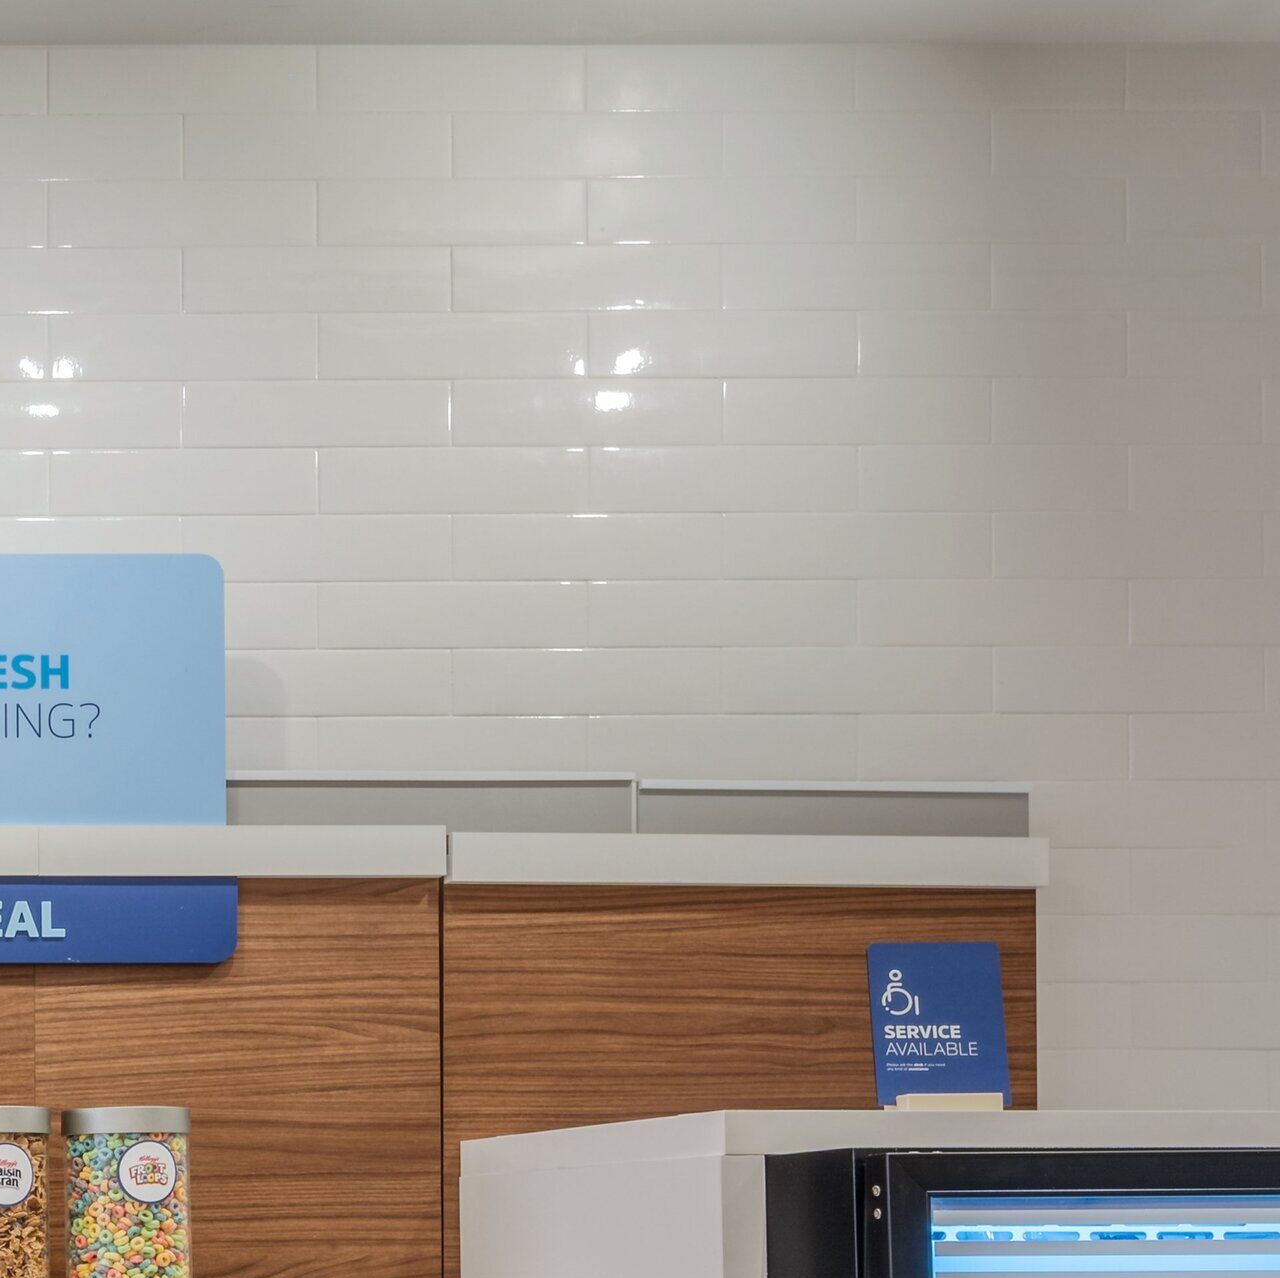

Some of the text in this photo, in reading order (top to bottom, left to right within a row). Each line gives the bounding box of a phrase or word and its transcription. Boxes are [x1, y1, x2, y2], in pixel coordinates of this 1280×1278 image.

[884, 1025, 962, 1039] SERVICE
[886, 1042, 979, 1056] AVAILABLE
[136, 1172, 168, 1185] LOOPS
